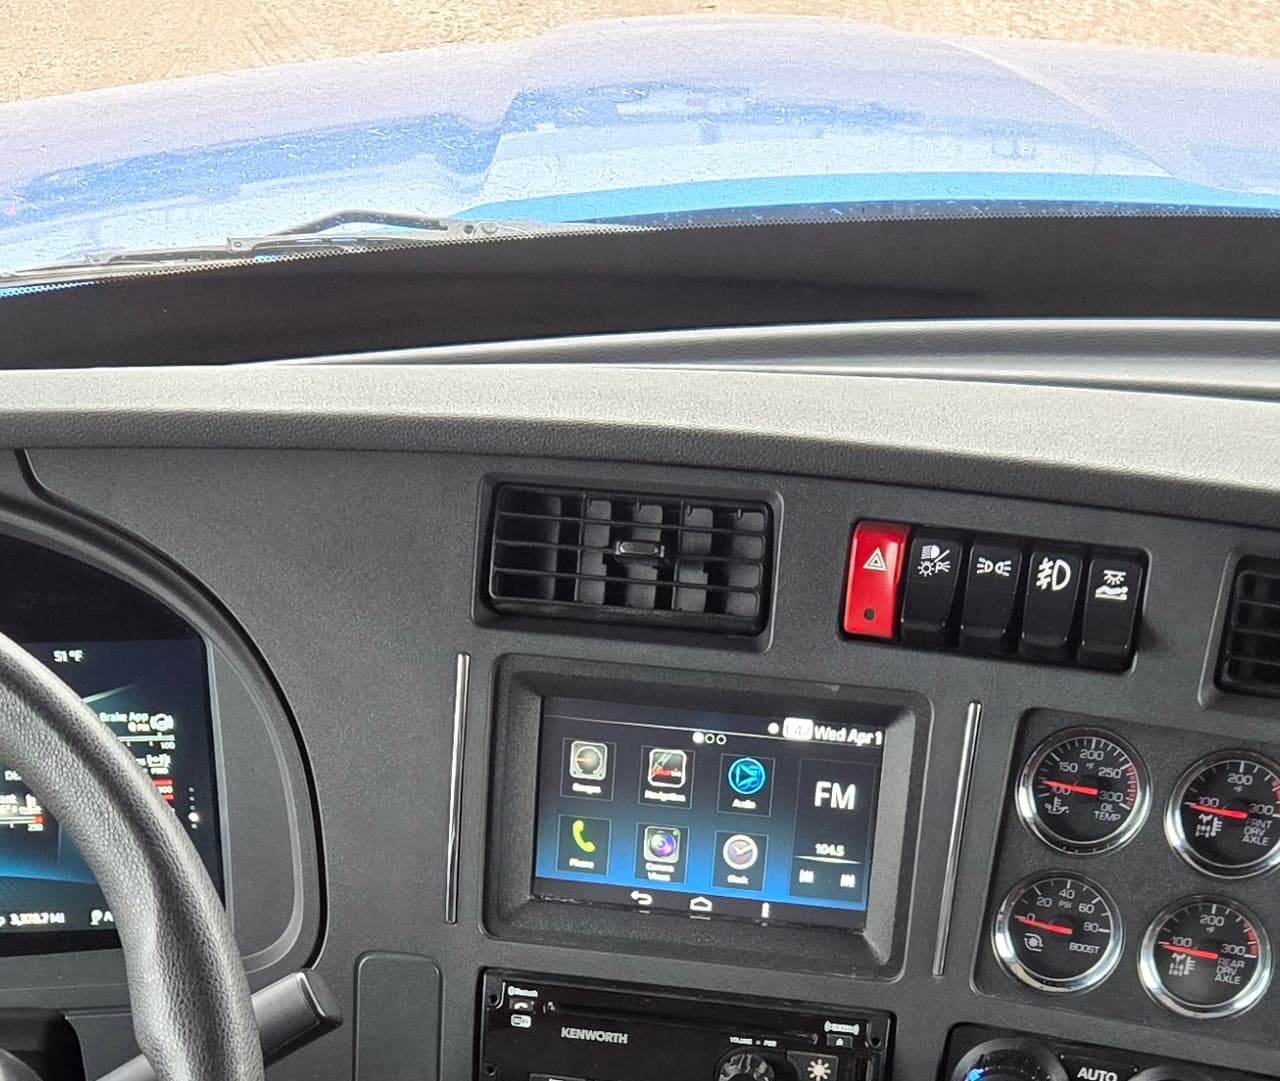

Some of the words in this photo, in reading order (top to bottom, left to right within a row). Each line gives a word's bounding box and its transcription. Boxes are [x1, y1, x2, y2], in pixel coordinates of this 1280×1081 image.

[814, 725, 847, 742] Wed
[847, 729, 872, 746] Apr
[873, 731, 883, 745] 1
[1079, 748, 1104, 761] 200
[1058, 761, 1079, 773] 150
[1098, 767, 1122, 779] 250
[1227, 772, 1253, 785] 200
[814, 781, 857, 810] FM
[1099, 790, 1124, 802] 300
[1100, 802, 1115, 812] OIL
[1248, 803, 1274, 816] 300
[1093, 810, 1121, 822] TEMP
[1241, 834, 1270, 847] AXLE
[1058, 888, 1076, 900] 40
[1036, 896, 1053, 908] 20
[1078, 902, 1095, 914] 60
[1083, 921, 1099, 933] 80
[1199, 914, 1225, 927] 200
[1069, 941, 1100, 954] BOOST
[1170, 935, 1194, 948] 100
[1220, 943, 1246, 956] 300
[1214, 973, 1242, 986] AXLE
[560, 1026, 629, 1045] KENWORTH
